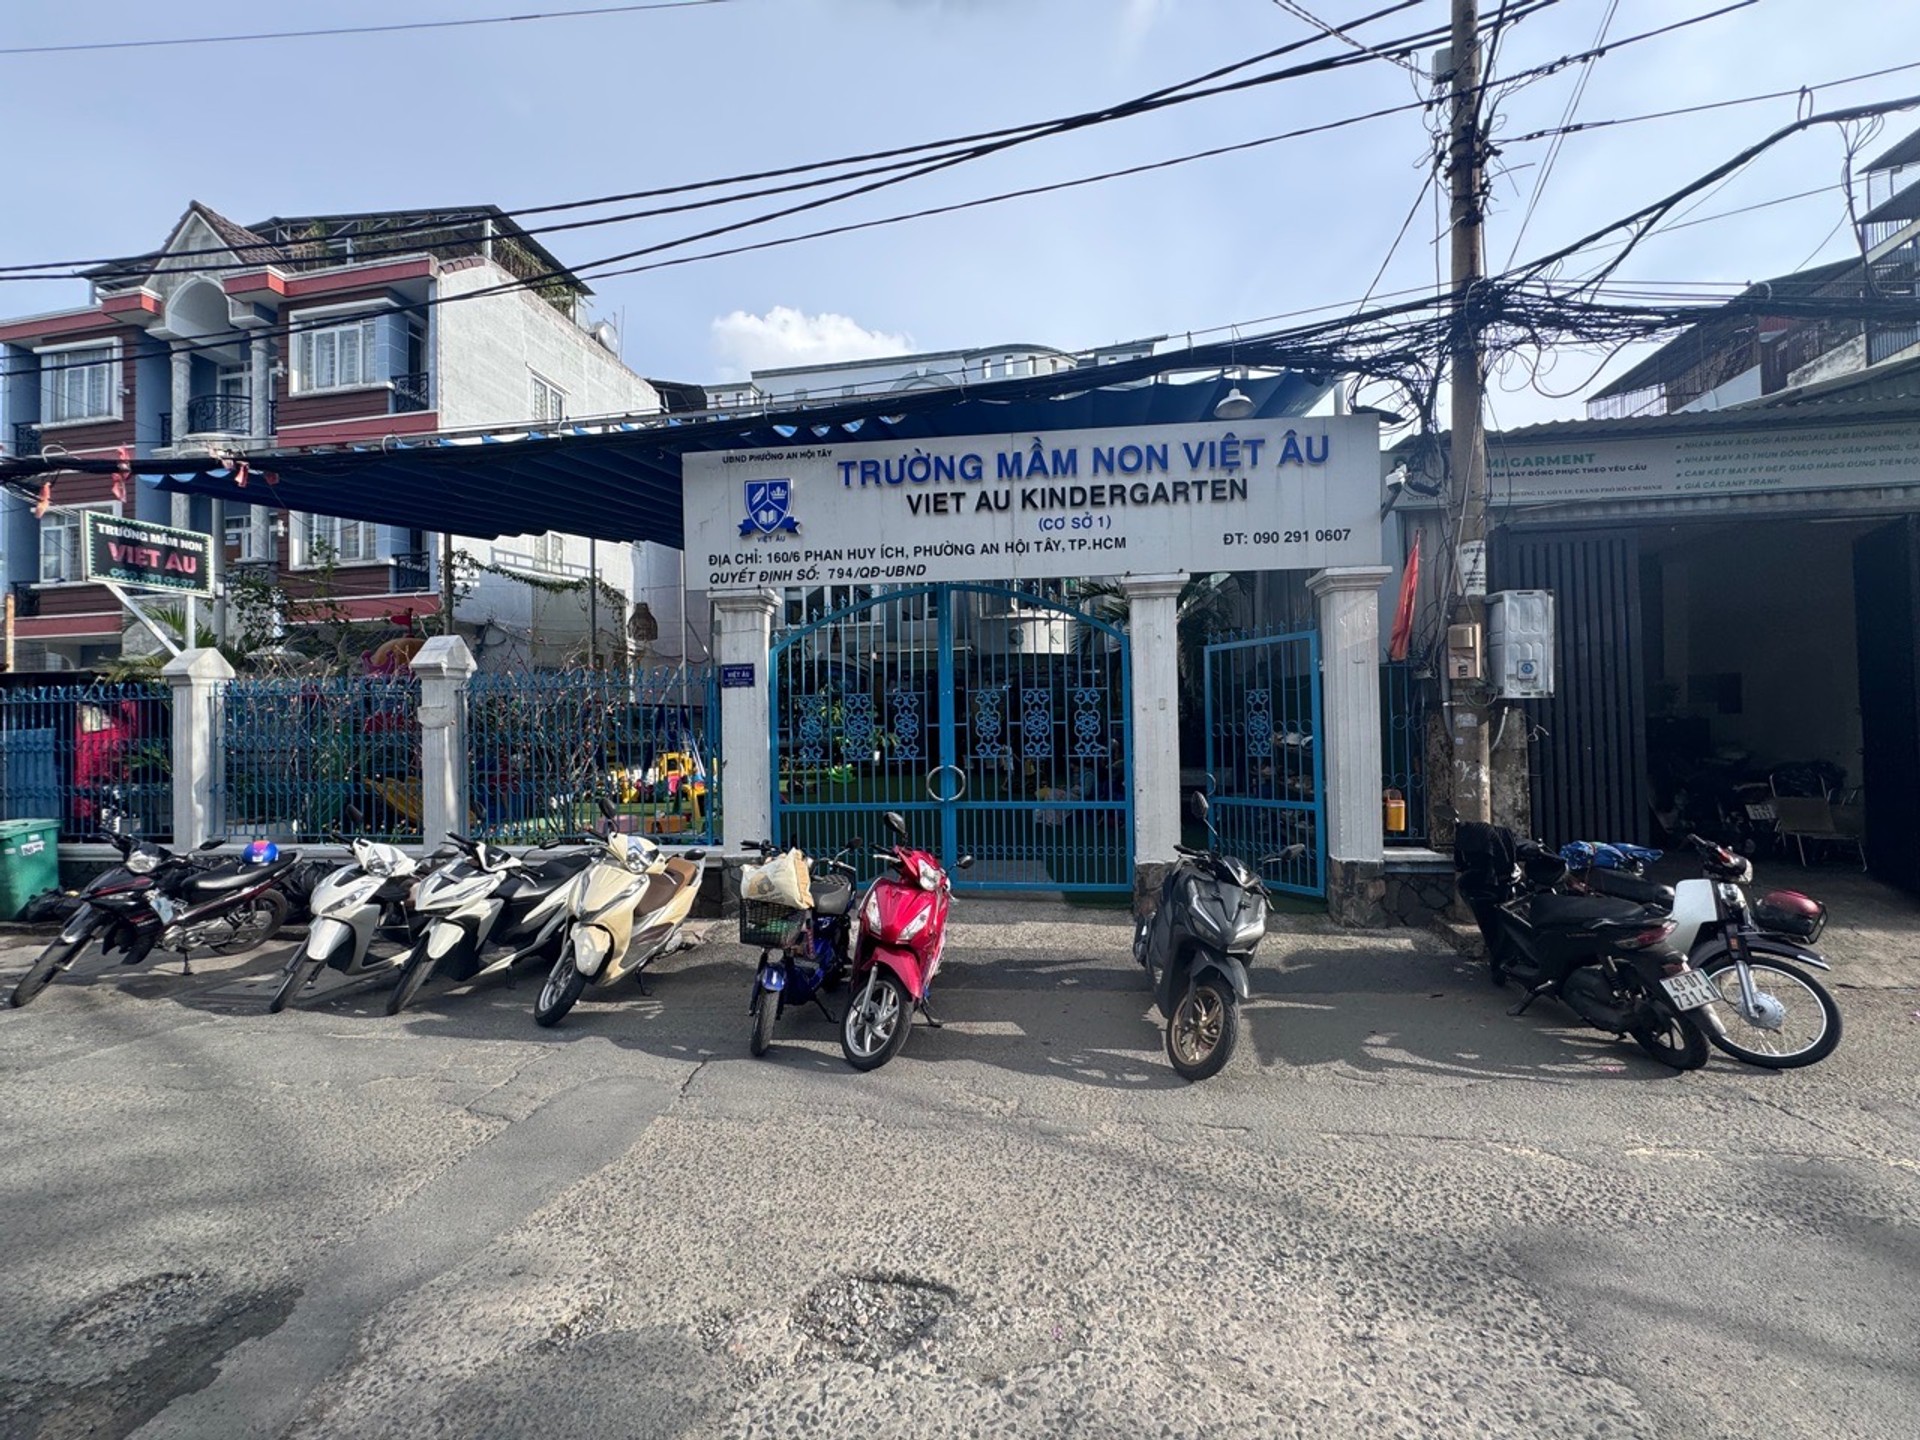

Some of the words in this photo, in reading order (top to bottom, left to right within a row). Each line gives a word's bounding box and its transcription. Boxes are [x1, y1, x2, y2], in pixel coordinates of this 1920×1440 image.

[722, 455, 747, 464] UBND
[786, 452, 798, 460] AN
[837, 448, 983, 487] TRƯỜNG
[997, 436, 1078, 480] MẦM
[1092, 443, 1169, 475] NON
[1182, 432, 1265, 476] VIỆT
[1277, 429, 1330, 467] ÂU
[1510, 453, 1596, 467] GARMENT
[1583, 466, 1606, 474] THEO
[906, 491, 966, 515] VIET
[975, 489, 1010, 512] AU
[1021, 478, 1248, 509] KINDERGARTEN
[1038, 516, 1065, 532] (CƠ
[1071, 512, 1093, 530] SỞ
[1098, 515, 1111, 530] 1)
[180, 539, 203, 552] NON
[1223, 532, 1248, 546] ĐT:
[1253, 531, 1279, 545] 090
[1284, 530, 1309, 543] 291
[1315, 529, 1351, 542] 0607
[708, 552, 731, 568] ĐỊA
[734, 547, 762, 566] CHỈ:
[767, 550, 800, 565] 160/6
[804, 549, 843, 562] PHAN
[847, 547, 876, 560] HUY
[880, 543, 909, 560] ÍCH,
[913, 541, 975, 558] PHƯỜNG
[981, 543, 999, 555] AN
[1004, 538, 1030, 555] HỘI
[1034, 536, 1066, 553] TÂY,
[1068, 536, 1127, 551] TP.HCM
[710, 566, 754, 584] QUYẾT
[756, 569, 793, 584] ĐỊNH
[797, 563, 820, 581] SỐ:
[828, 564, 926, 580] 794/QĐ-UBND
